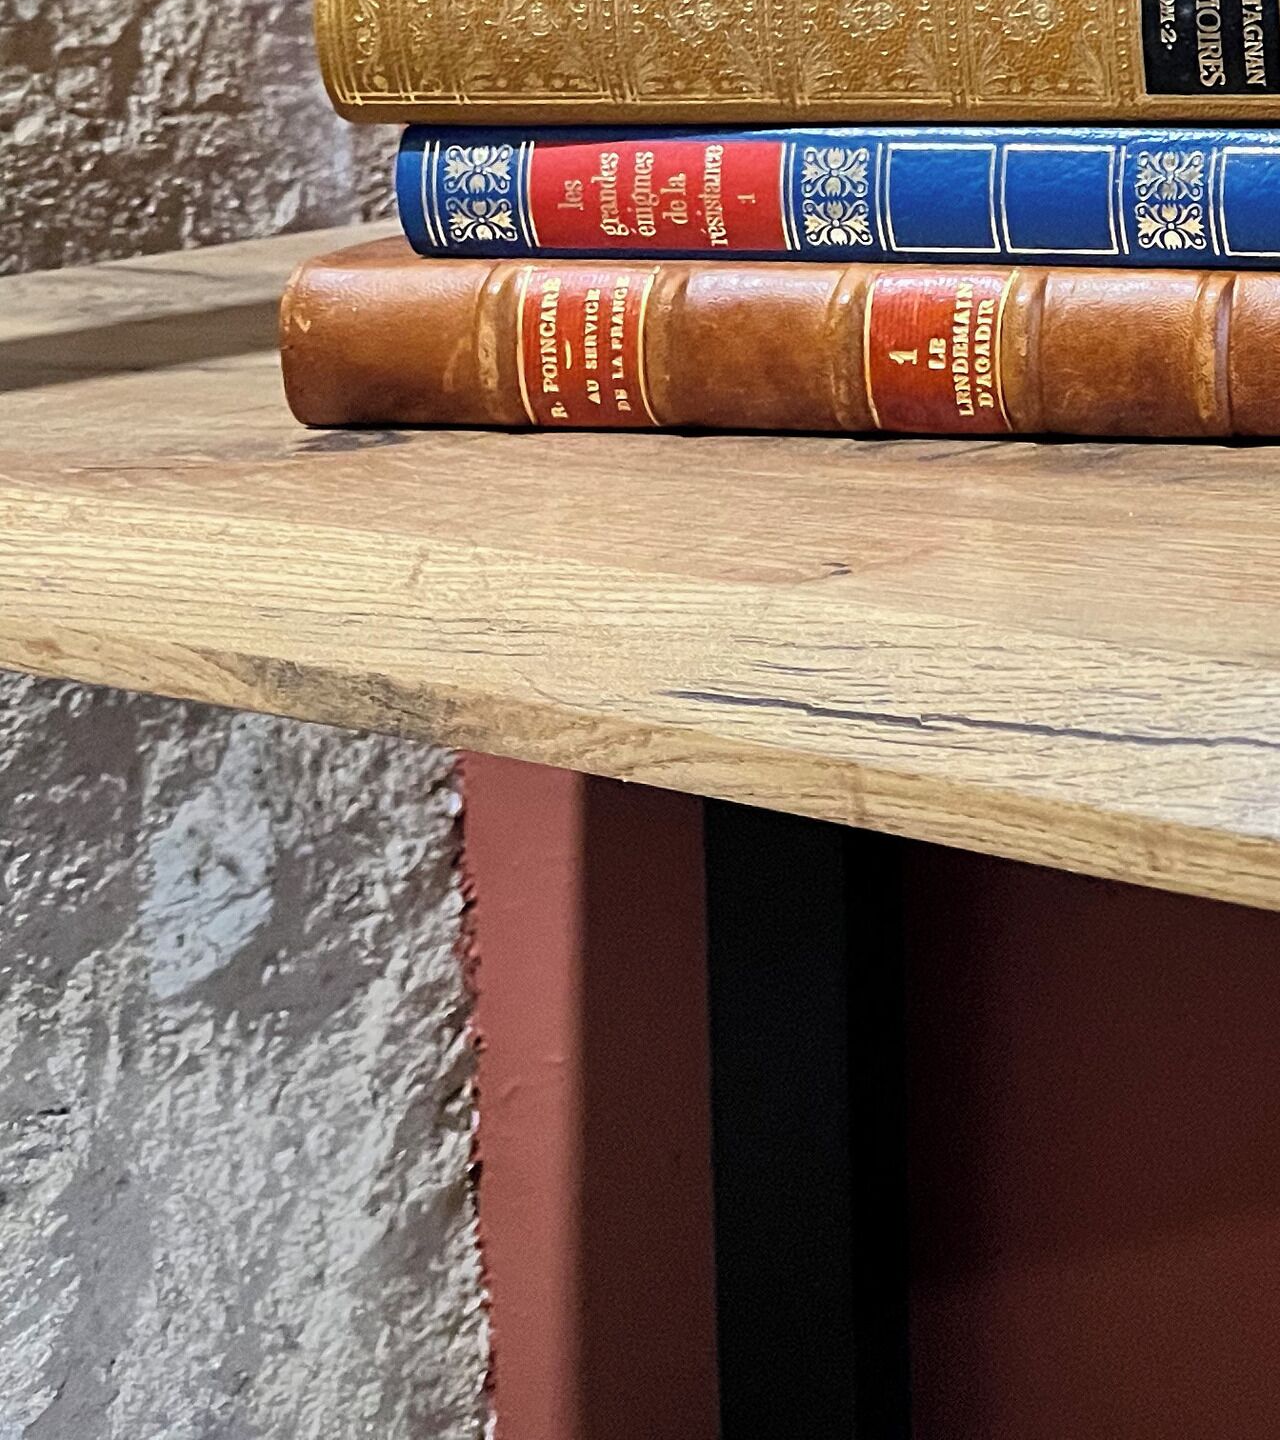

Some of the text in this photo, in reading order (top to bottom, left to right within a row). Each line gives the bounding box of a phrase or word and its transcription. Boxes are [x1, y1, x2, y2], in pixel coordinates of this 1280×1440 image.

[557, 179, 584, 210] les
[591, 152, 629, 236] grandes
[627, 151, 659, 236] énigmes
[660, 172, 688, 224] de la
[696, 144, 729, 245] résistance
[584, 288, 600, 404] AU SERVICE
[610, 276, 631, 410] DE LA FRANCE
[888, 349, 918, 365] 1
[928, 337, 946, 369] LE
[952, 282, 974, 416] LENDEMAIN
[974, 299, 994, 407] D'AGADIR
[551, 401, 569, 418] R.
